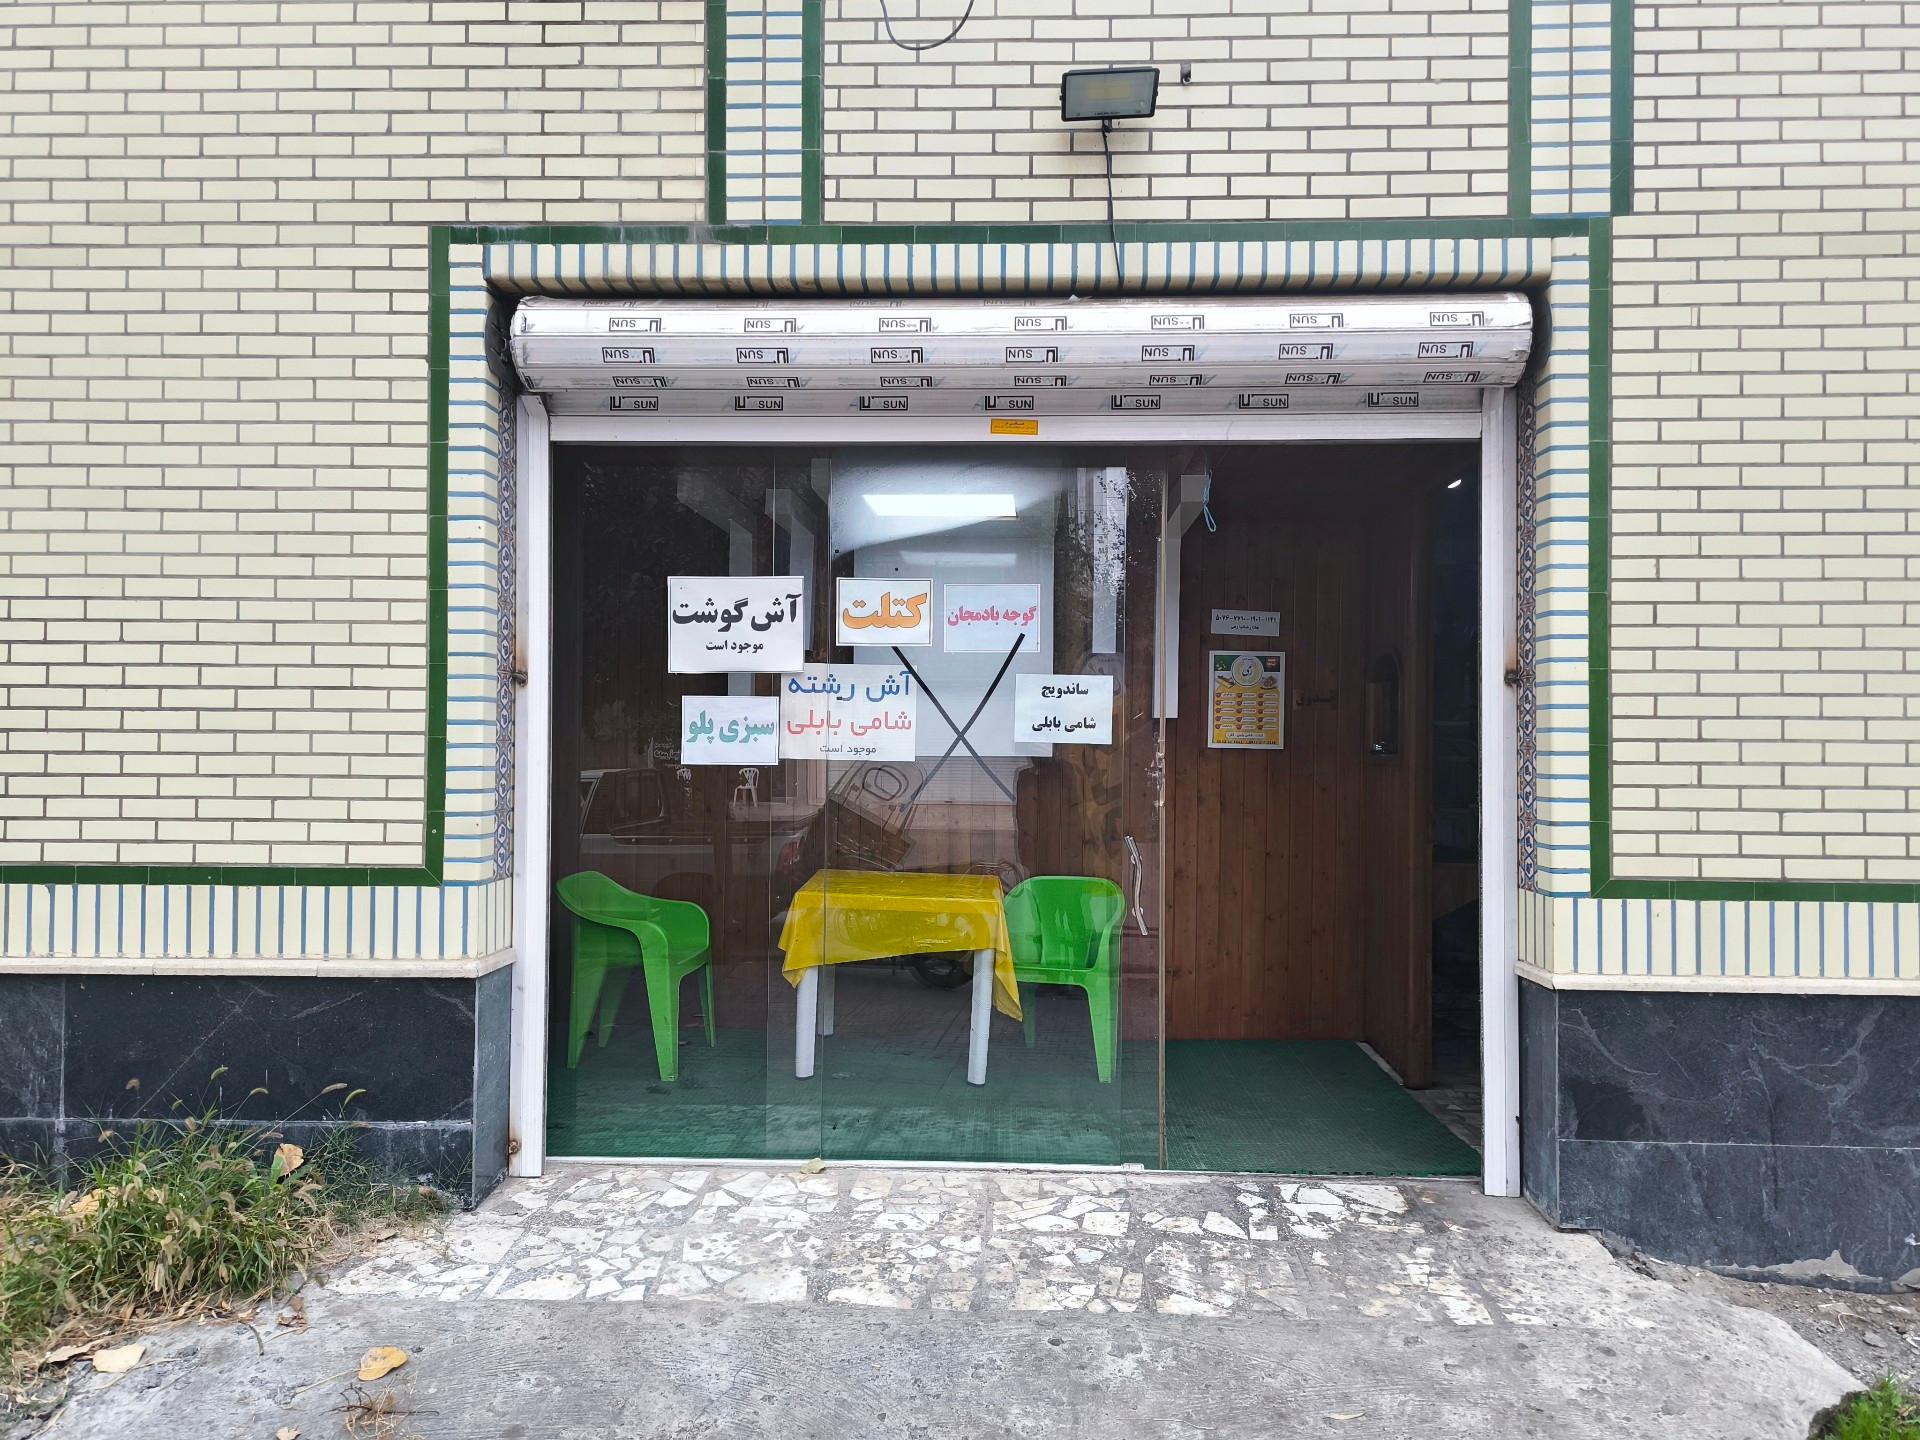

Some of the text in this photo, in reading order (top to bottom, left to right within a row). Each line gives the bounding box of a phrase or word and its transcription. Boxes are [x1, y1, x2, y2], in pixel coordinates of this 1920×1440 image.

[1153, 317, 1179, 326] SUN
[1292, 315, 1317, 324] SUN
[1432, 313, 1458, 322] SUN
[611, 319, 636, 328] SUN
[747, 320, 771, 329] SUN
[881, 320, 906, 328] SUN
[1017, 319, 1042, 327] SUN
[1008, 349, 1033, 358] SUN
[1144, 347, 1169, 357] SUN
[1281, 345, 1307, 355] SUN
[1421, 344, 1447, 354] SUN
[605, 349, 630, 359] SUN
[739, 349, 764, 359] SUN
[873, 349, 898, 359] SUN
[616, 377, 640, 385] SUN
[1017, 376, 1042, 384] SUN
[1152, 375, 1176, 383] SUN
[1288, 374, 1313, 382] SUN
[1427, 372, 1453, 381] SUN
[633, 400, 657, 409] SUN
[758, 400, 781, 409] SUN
[883, 400, 906, 409] SUN
[1008, 399, 1032, 409] SUN
[1135, 398, 1159, 408] SUN
[1262, 398, 1287, 407] SUN
[1392, 396, 1416, 405] SUN
[672, 593, 802, 632] آش گوشت
[842, 591, 928, 630] کتلت
[947, 605, 1037, 626] گوجه بادمجان
[705, 639, 764, 654] موجود است
[787, 670, 911, 702] آش رشته
[686, 710, 774, 744] سبزی پلو
[786, 709, 912, 736] شامی بابلی
[1031, 715, 1097, 733] شامی بابلی
[819, 744, 877, 756] موجود است
